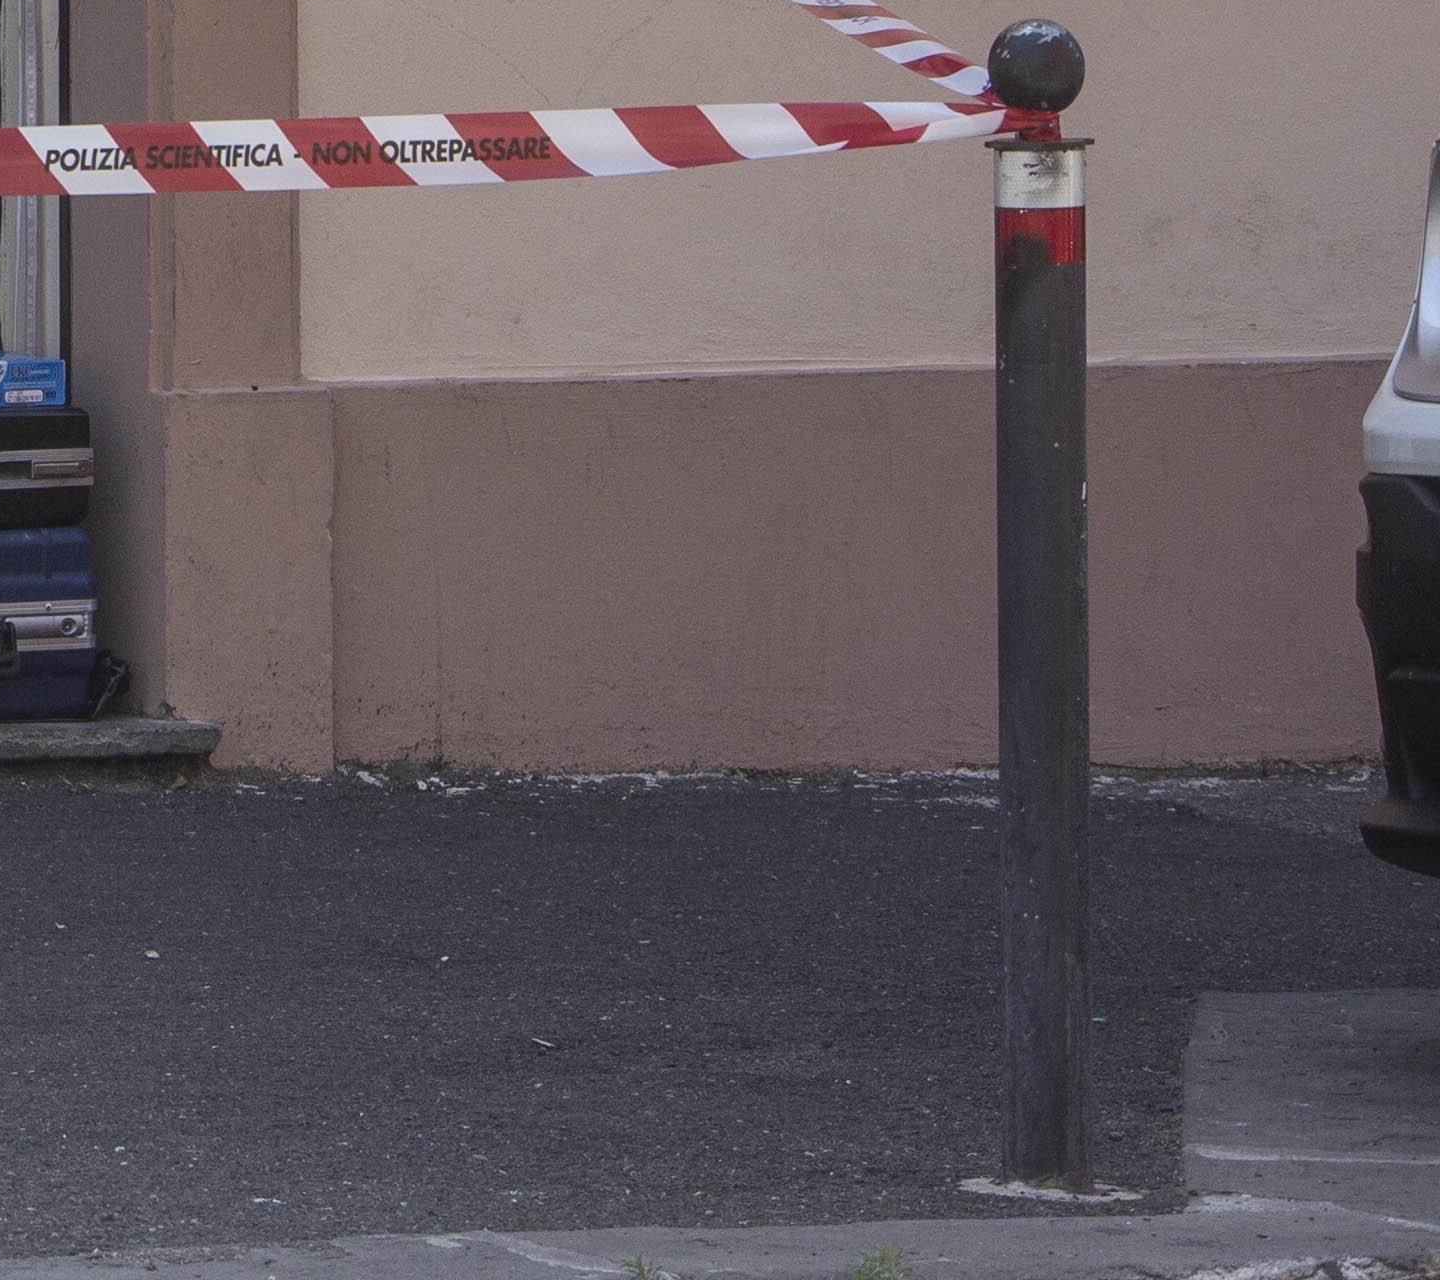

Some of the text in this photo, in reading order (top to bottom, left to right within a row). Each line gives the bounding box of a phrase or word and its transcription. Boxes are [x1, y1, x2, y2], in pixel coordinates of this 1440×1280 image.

[43, 147, 139, 174] POLIZIA
[145, 143, 284, 171] SCIENTIFICA
[311, 141, 372, 166] NON
[378, 136, 552, 164] OLTREPASSARE
